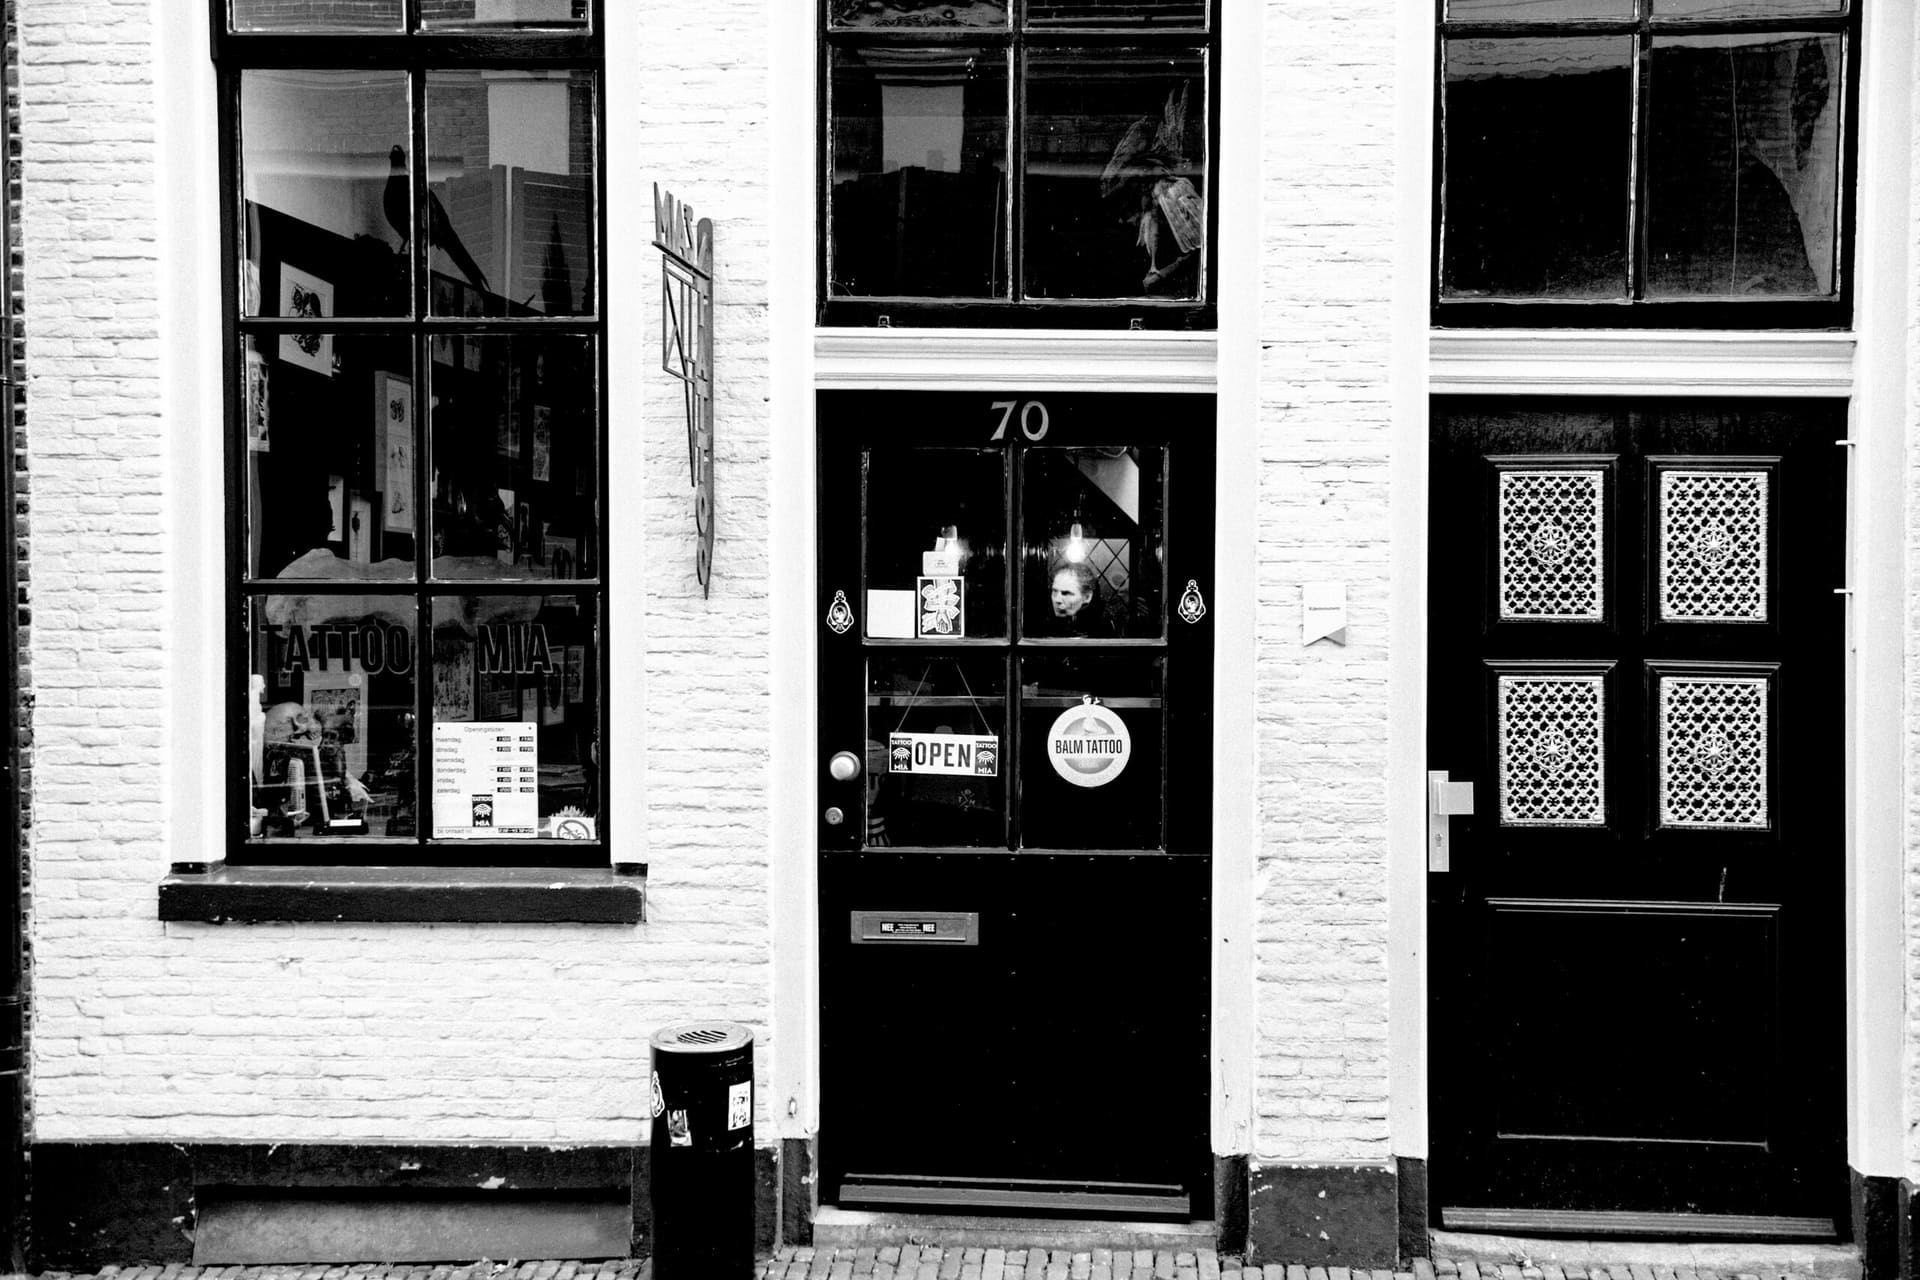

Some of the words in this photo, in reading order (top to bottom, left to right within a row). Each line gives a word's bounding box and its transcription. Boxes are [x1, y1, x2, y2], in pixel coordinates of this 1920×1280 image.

[989, 400, 1049, 441] 70
[260, 623, 411, 674] TATTOO
[477, 623, 553, 673] MIA
[915, 741, 971, 768] OPEN
[1055, 739, 1083, 754] BALM
[1086, 739, 1123, 754] TATTOO
[881, 923, 893, 931] NEE
[922, 923, 935, 932] NEE
